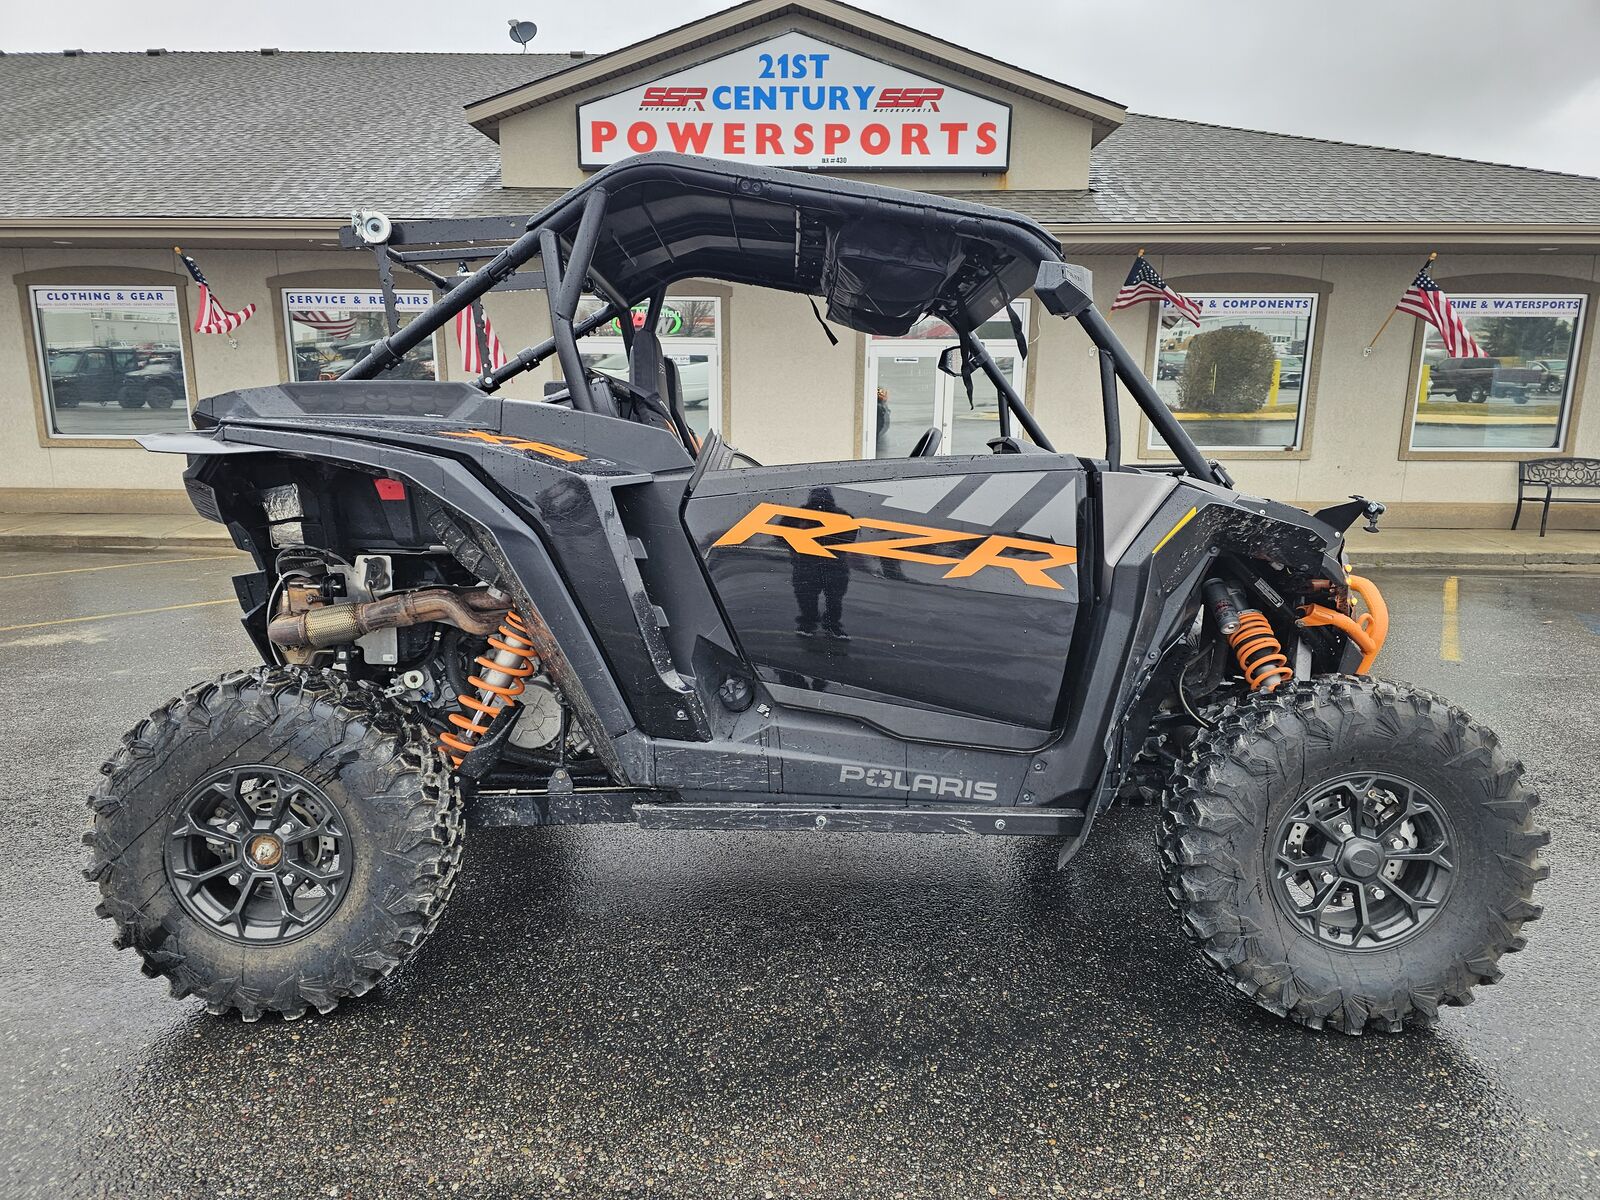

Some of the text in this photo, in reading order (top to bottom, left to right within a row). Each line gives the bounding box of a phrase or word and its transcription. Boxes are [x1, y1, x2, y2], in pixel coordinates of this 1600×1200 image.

[758, 53, 830, 79] 21ST
[640, 87, 708, 112] SSR
[711, 85, 876, 111] CENTURY
[875, 88, 944, 113] SSR
[591, 120, 998, 156] POWERSPORTS
[46, 292, 164, 301] CLOTHING & GEAR
[289, 295, 429, 305] SERVICE & REAIRS
[1209, 299, 1217, 308] &
[1222, 299, 1309, 309] COMPONENTS
[1480, 300, 1488, 309] &
[1493, 300, 1579, 309] WATERSPORTS
[712, 502, 1078, 590] RZR
[839, 765, 998, 801] POLARIS
